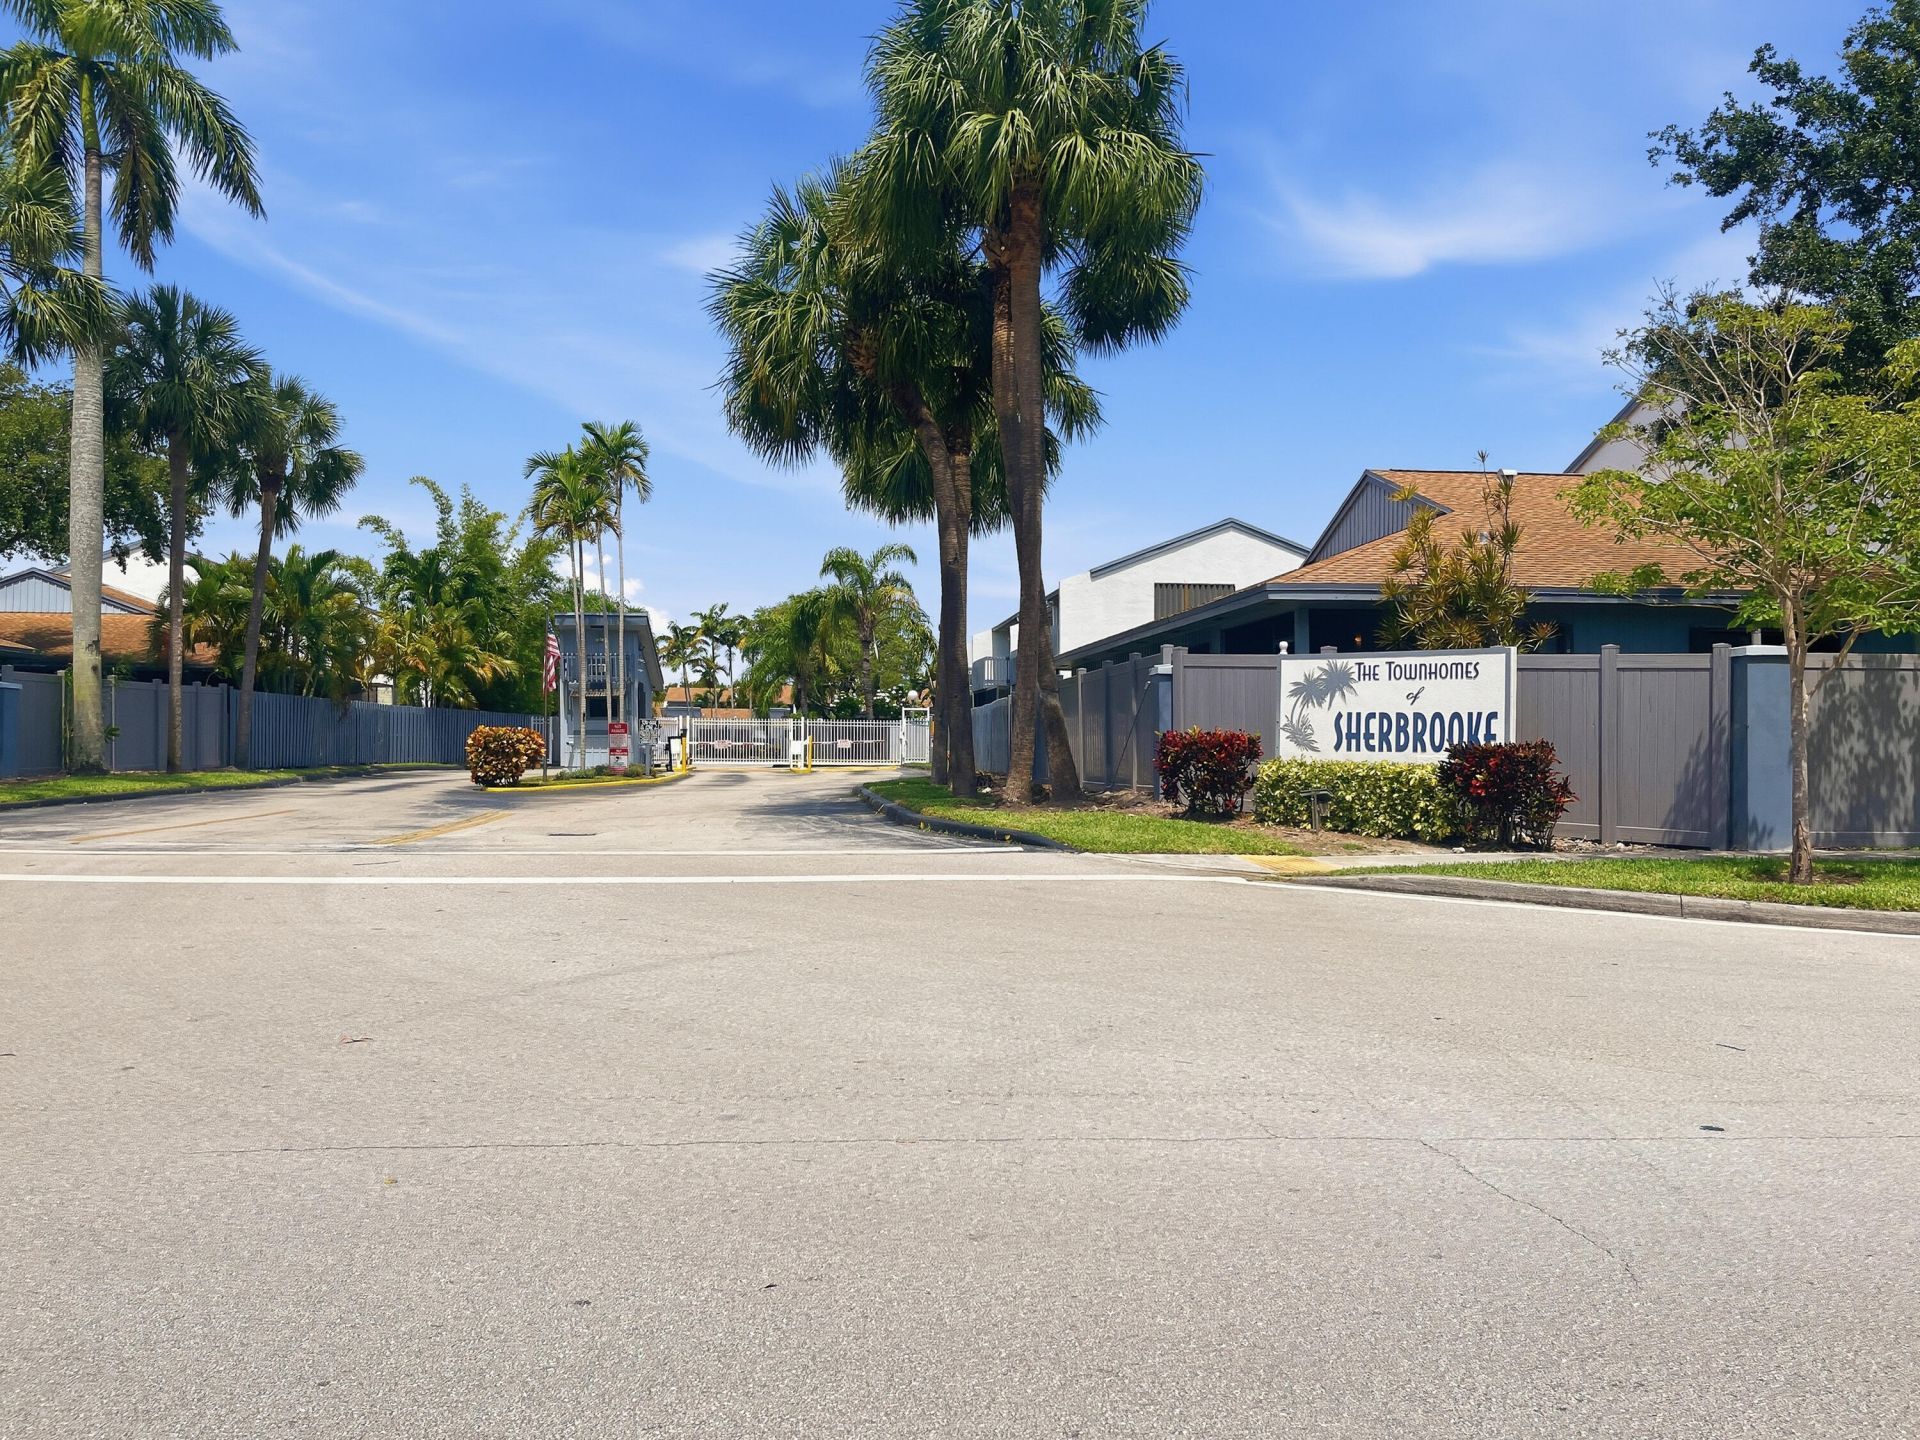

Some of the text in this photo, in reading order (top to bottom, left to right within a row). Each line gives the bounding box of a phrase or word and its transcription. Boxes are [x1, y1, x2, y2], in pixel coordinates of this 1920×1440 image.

[1355, 661, 1480, 681] THE TOWNHOMES
[1406, 686, 1425, 705] of
[1333, 711, 1498, 753] SHERBROOKE
